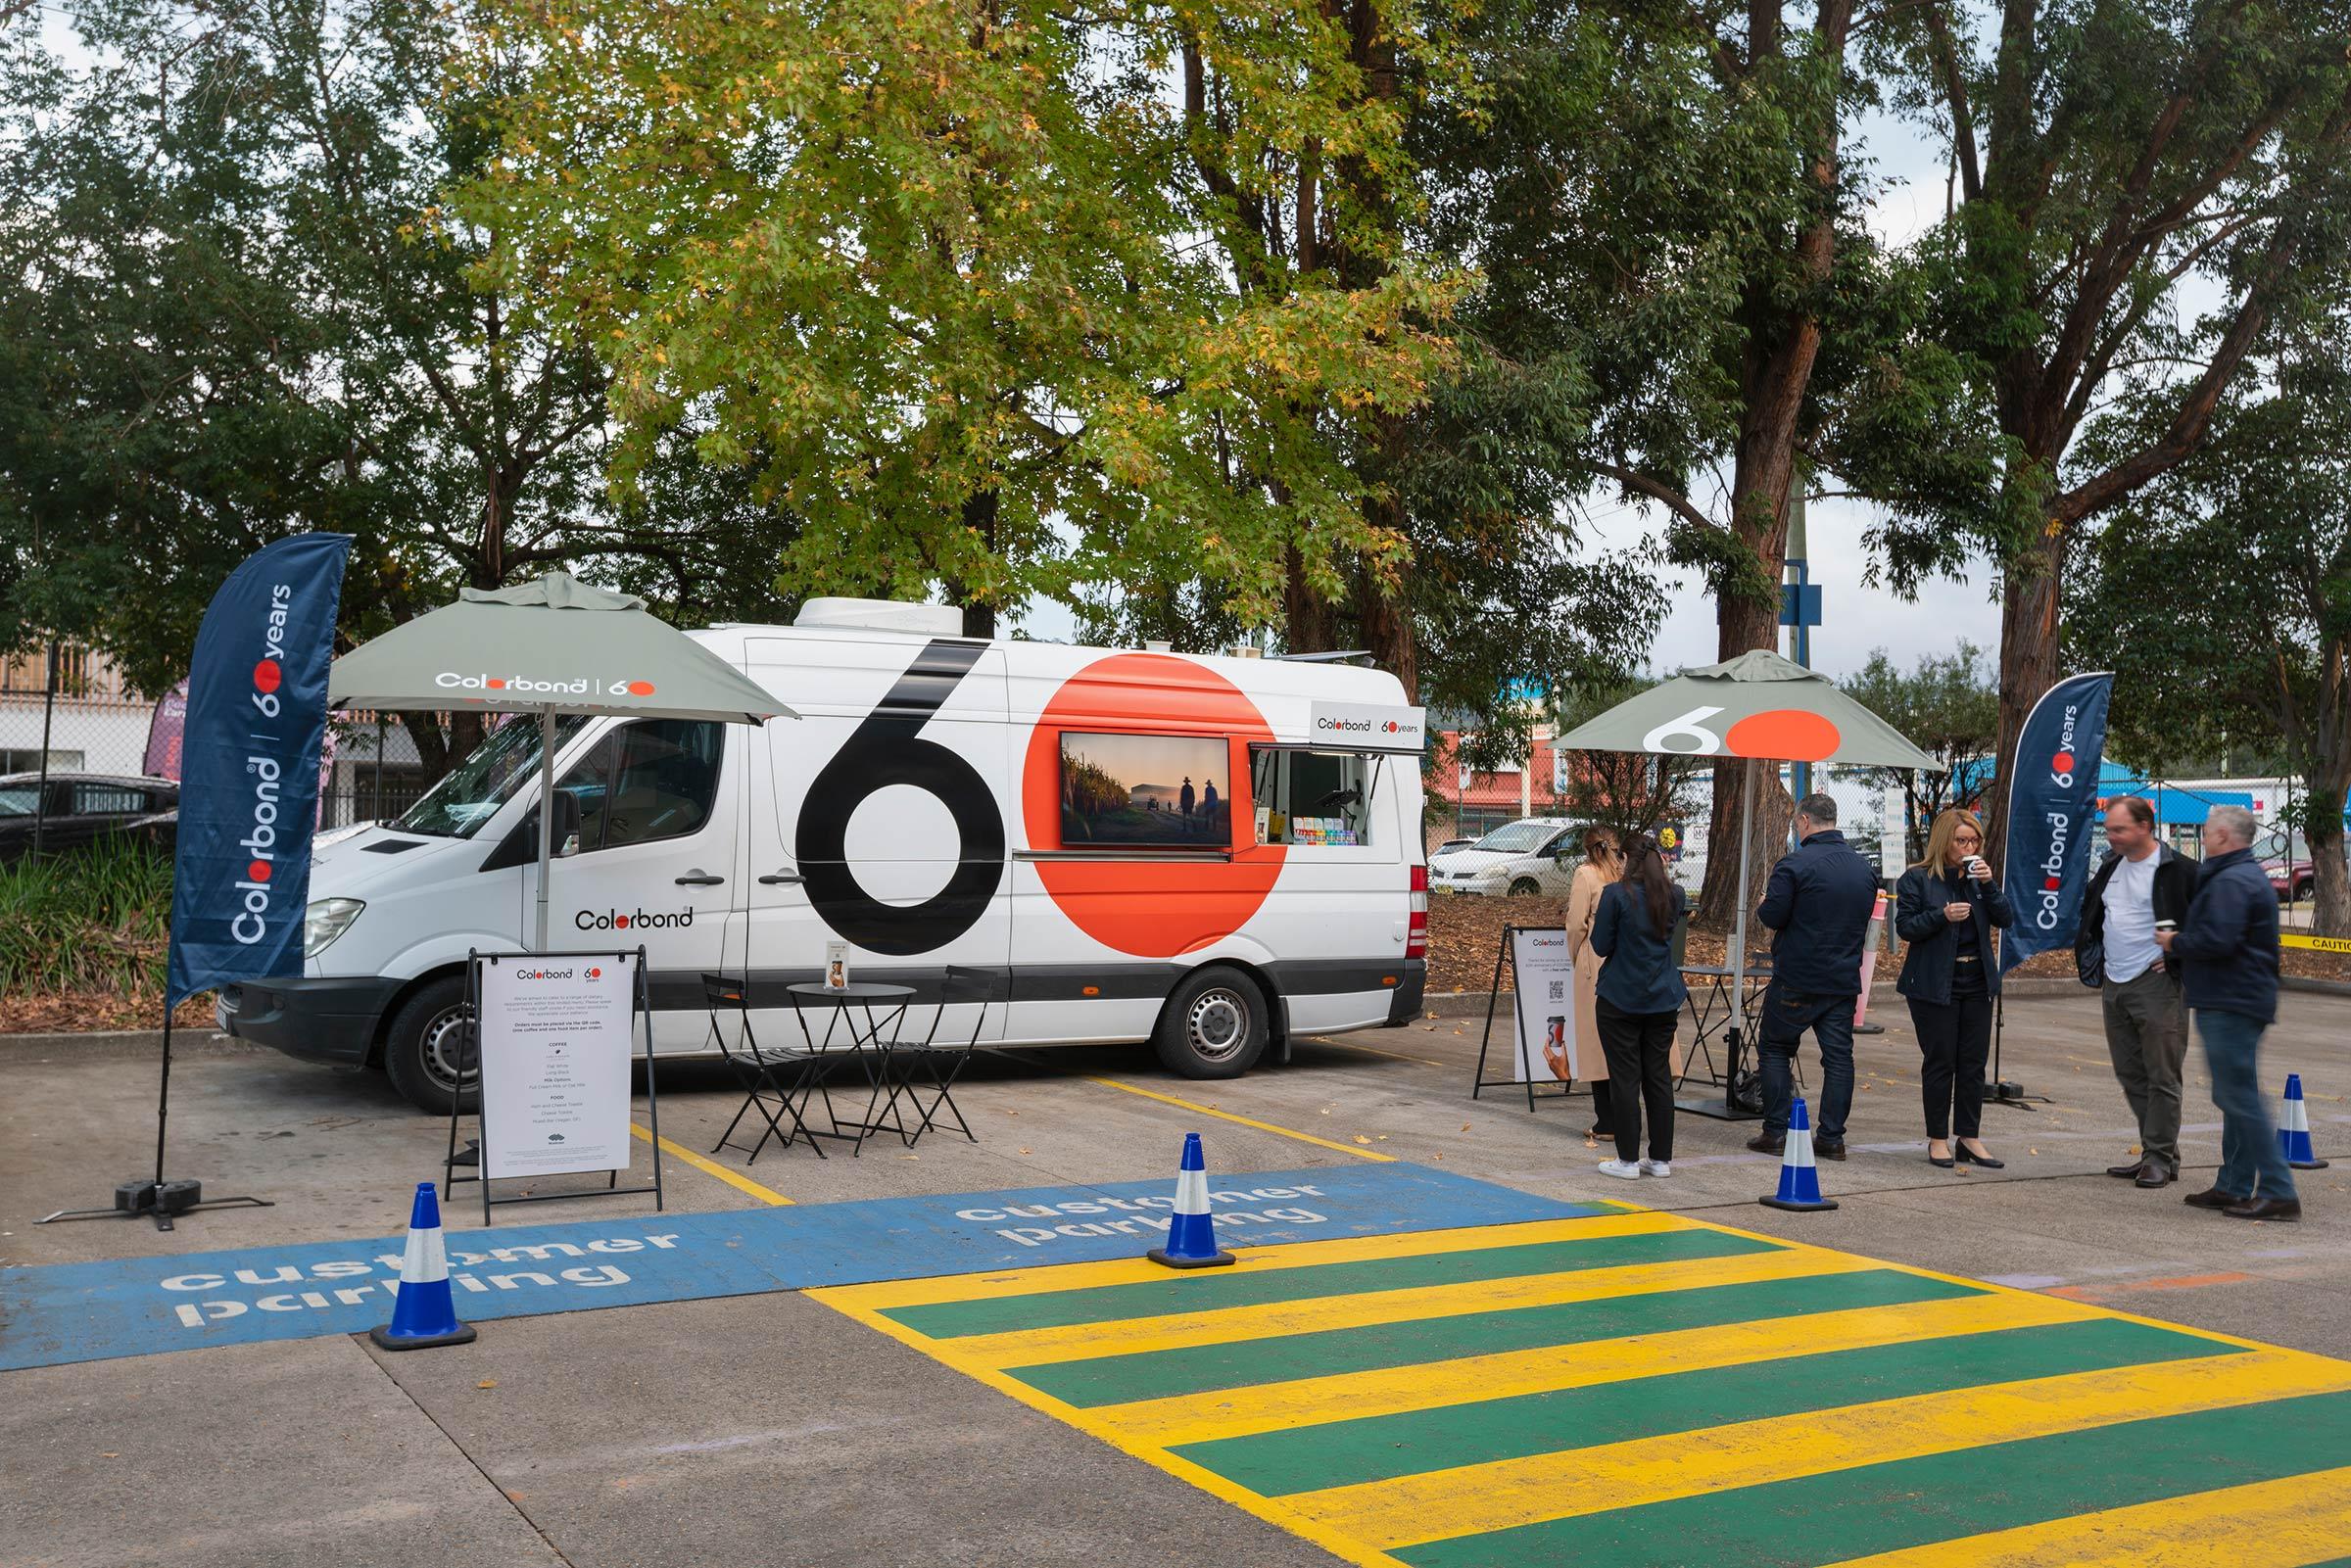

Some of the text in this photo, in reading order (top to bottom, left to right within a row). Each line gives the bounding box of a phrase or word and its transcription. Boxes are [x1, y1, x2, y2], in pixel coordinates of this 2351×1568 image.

[575, 906, 693, 930] Colorbond
[517, 968, 572, 980] Colorbond
[174, 1265, 631, 1328] paring
